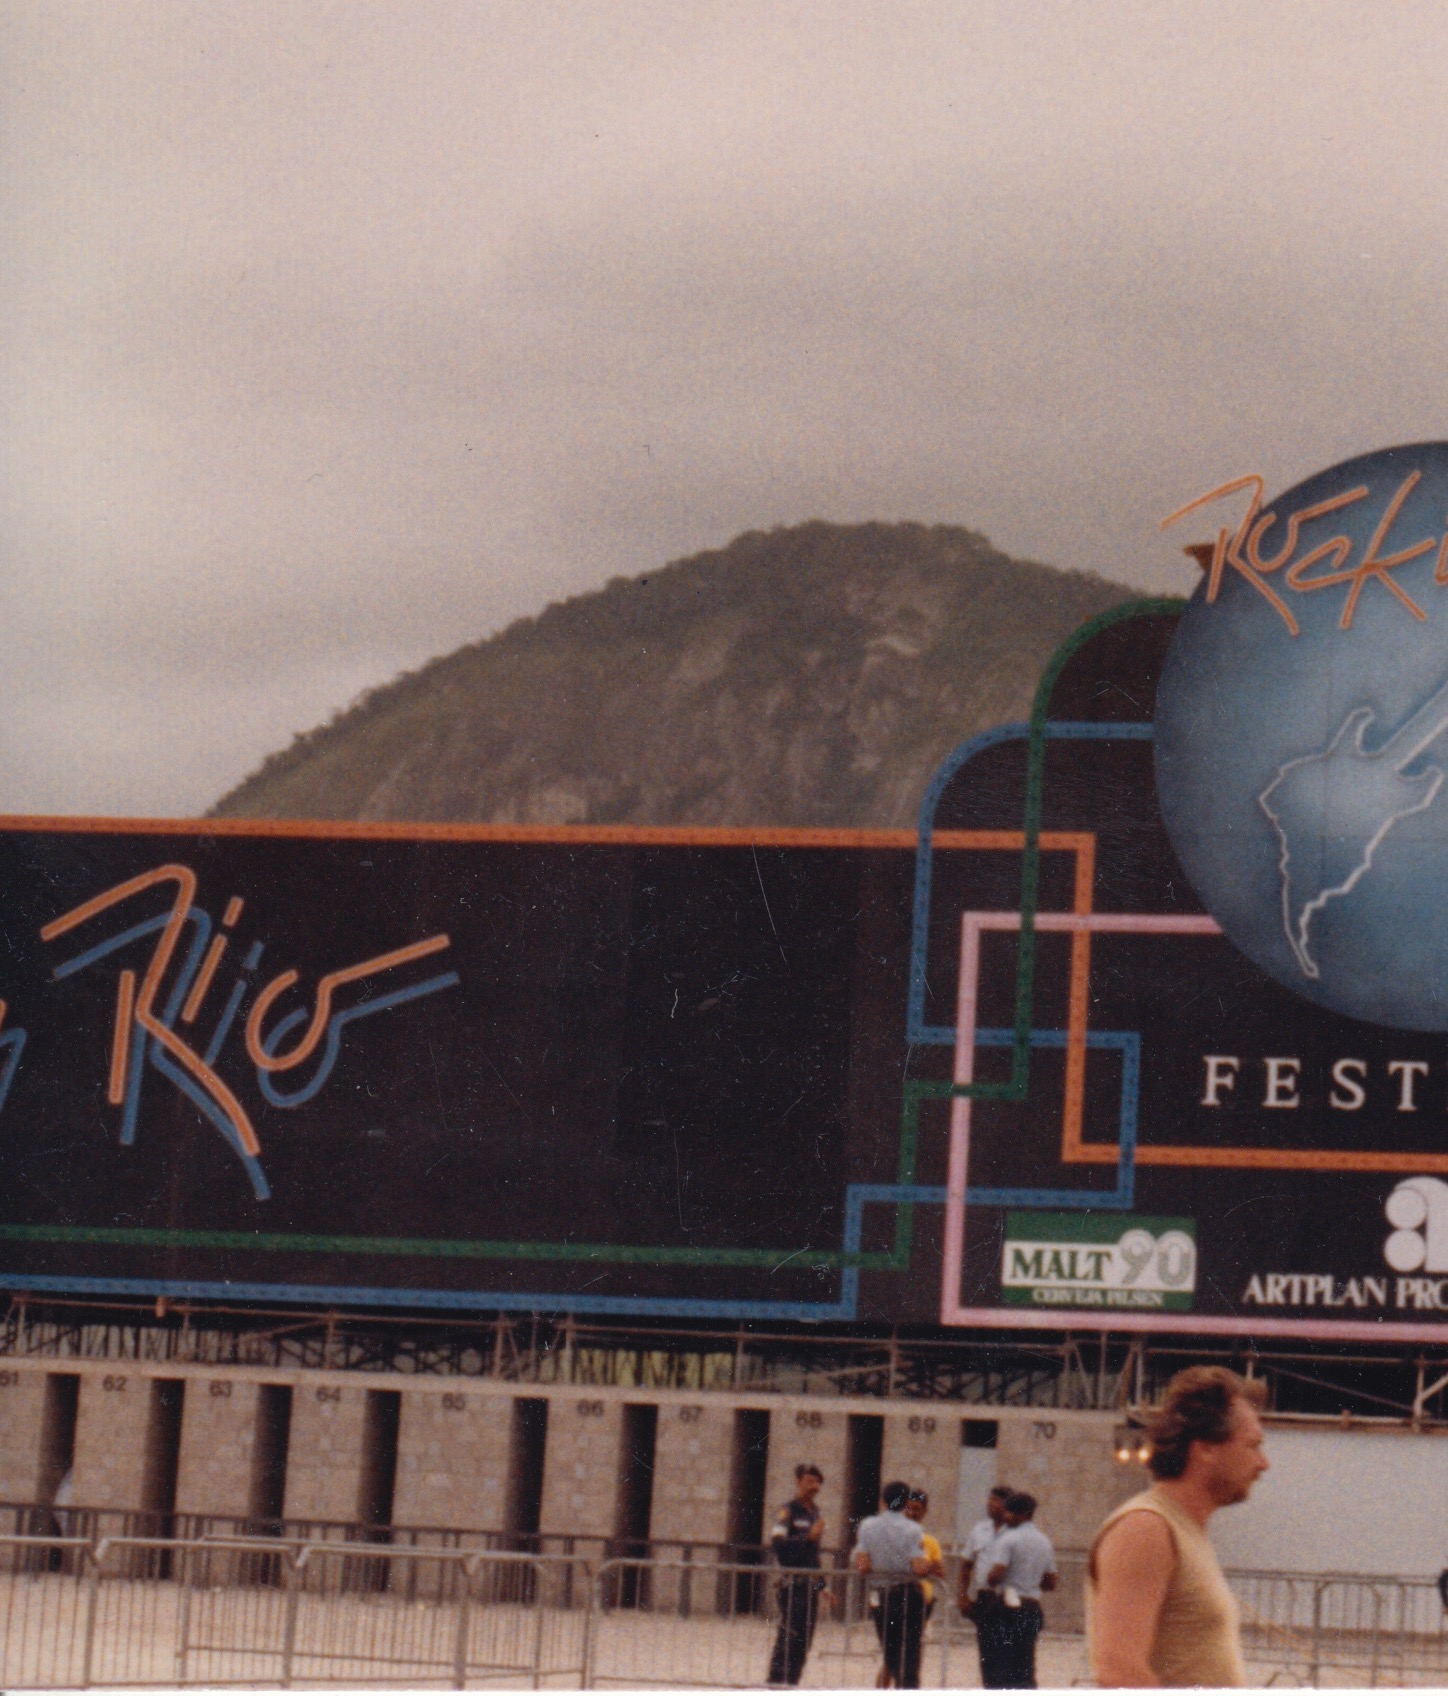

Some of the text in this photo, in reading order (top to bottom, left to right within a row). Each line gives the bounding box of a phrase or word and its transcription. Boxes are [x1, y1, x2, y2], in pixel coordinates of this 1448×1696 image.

[1158, 471, 1435, 637] Rock
[40, 863, 452, 1160] Rio
[1010, 1228, 1198, 1287] MALT 90
[1242, 1272, 1387, 1308] ARTPLAN
[102, 1374, 127, 1393] 62
[208, 1379, 233, 1398] 63
[315, 1384, 342, 1403] 64
[796, 1411, 823, 1430] 68
[908, 1415, 937, 1435] 69
[1032, 1420, 1057, 1441] 70
